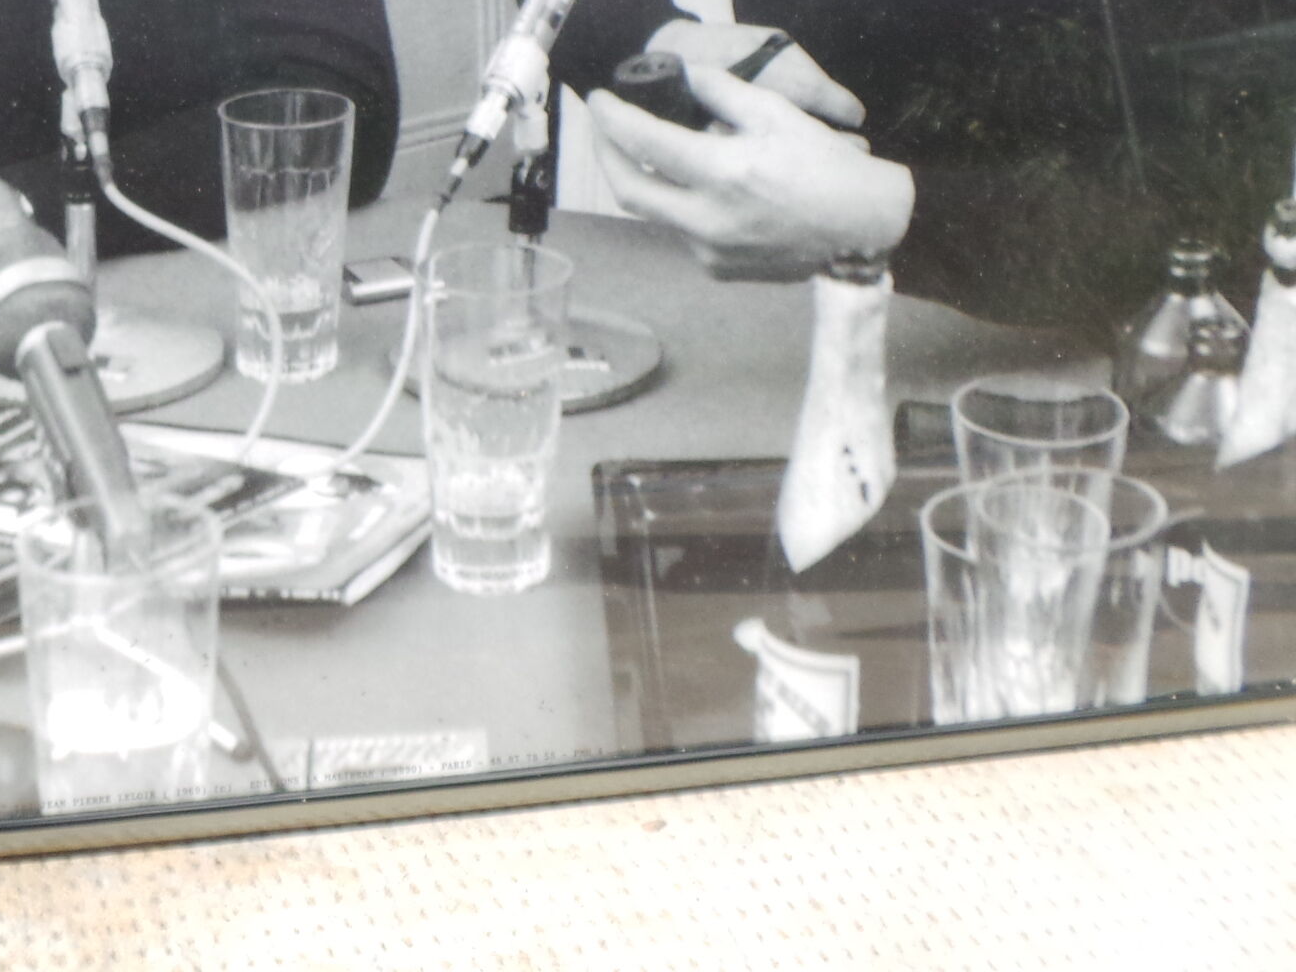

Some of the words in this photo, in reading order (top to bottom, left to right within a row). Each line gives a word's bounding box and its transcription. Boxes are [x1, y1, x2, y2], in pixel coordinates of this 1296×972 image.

[73, 795, 111, 807] PIERRE
[117, 790, 155, 803] LELOIR
[441, 761, 473, 772] PARIS
